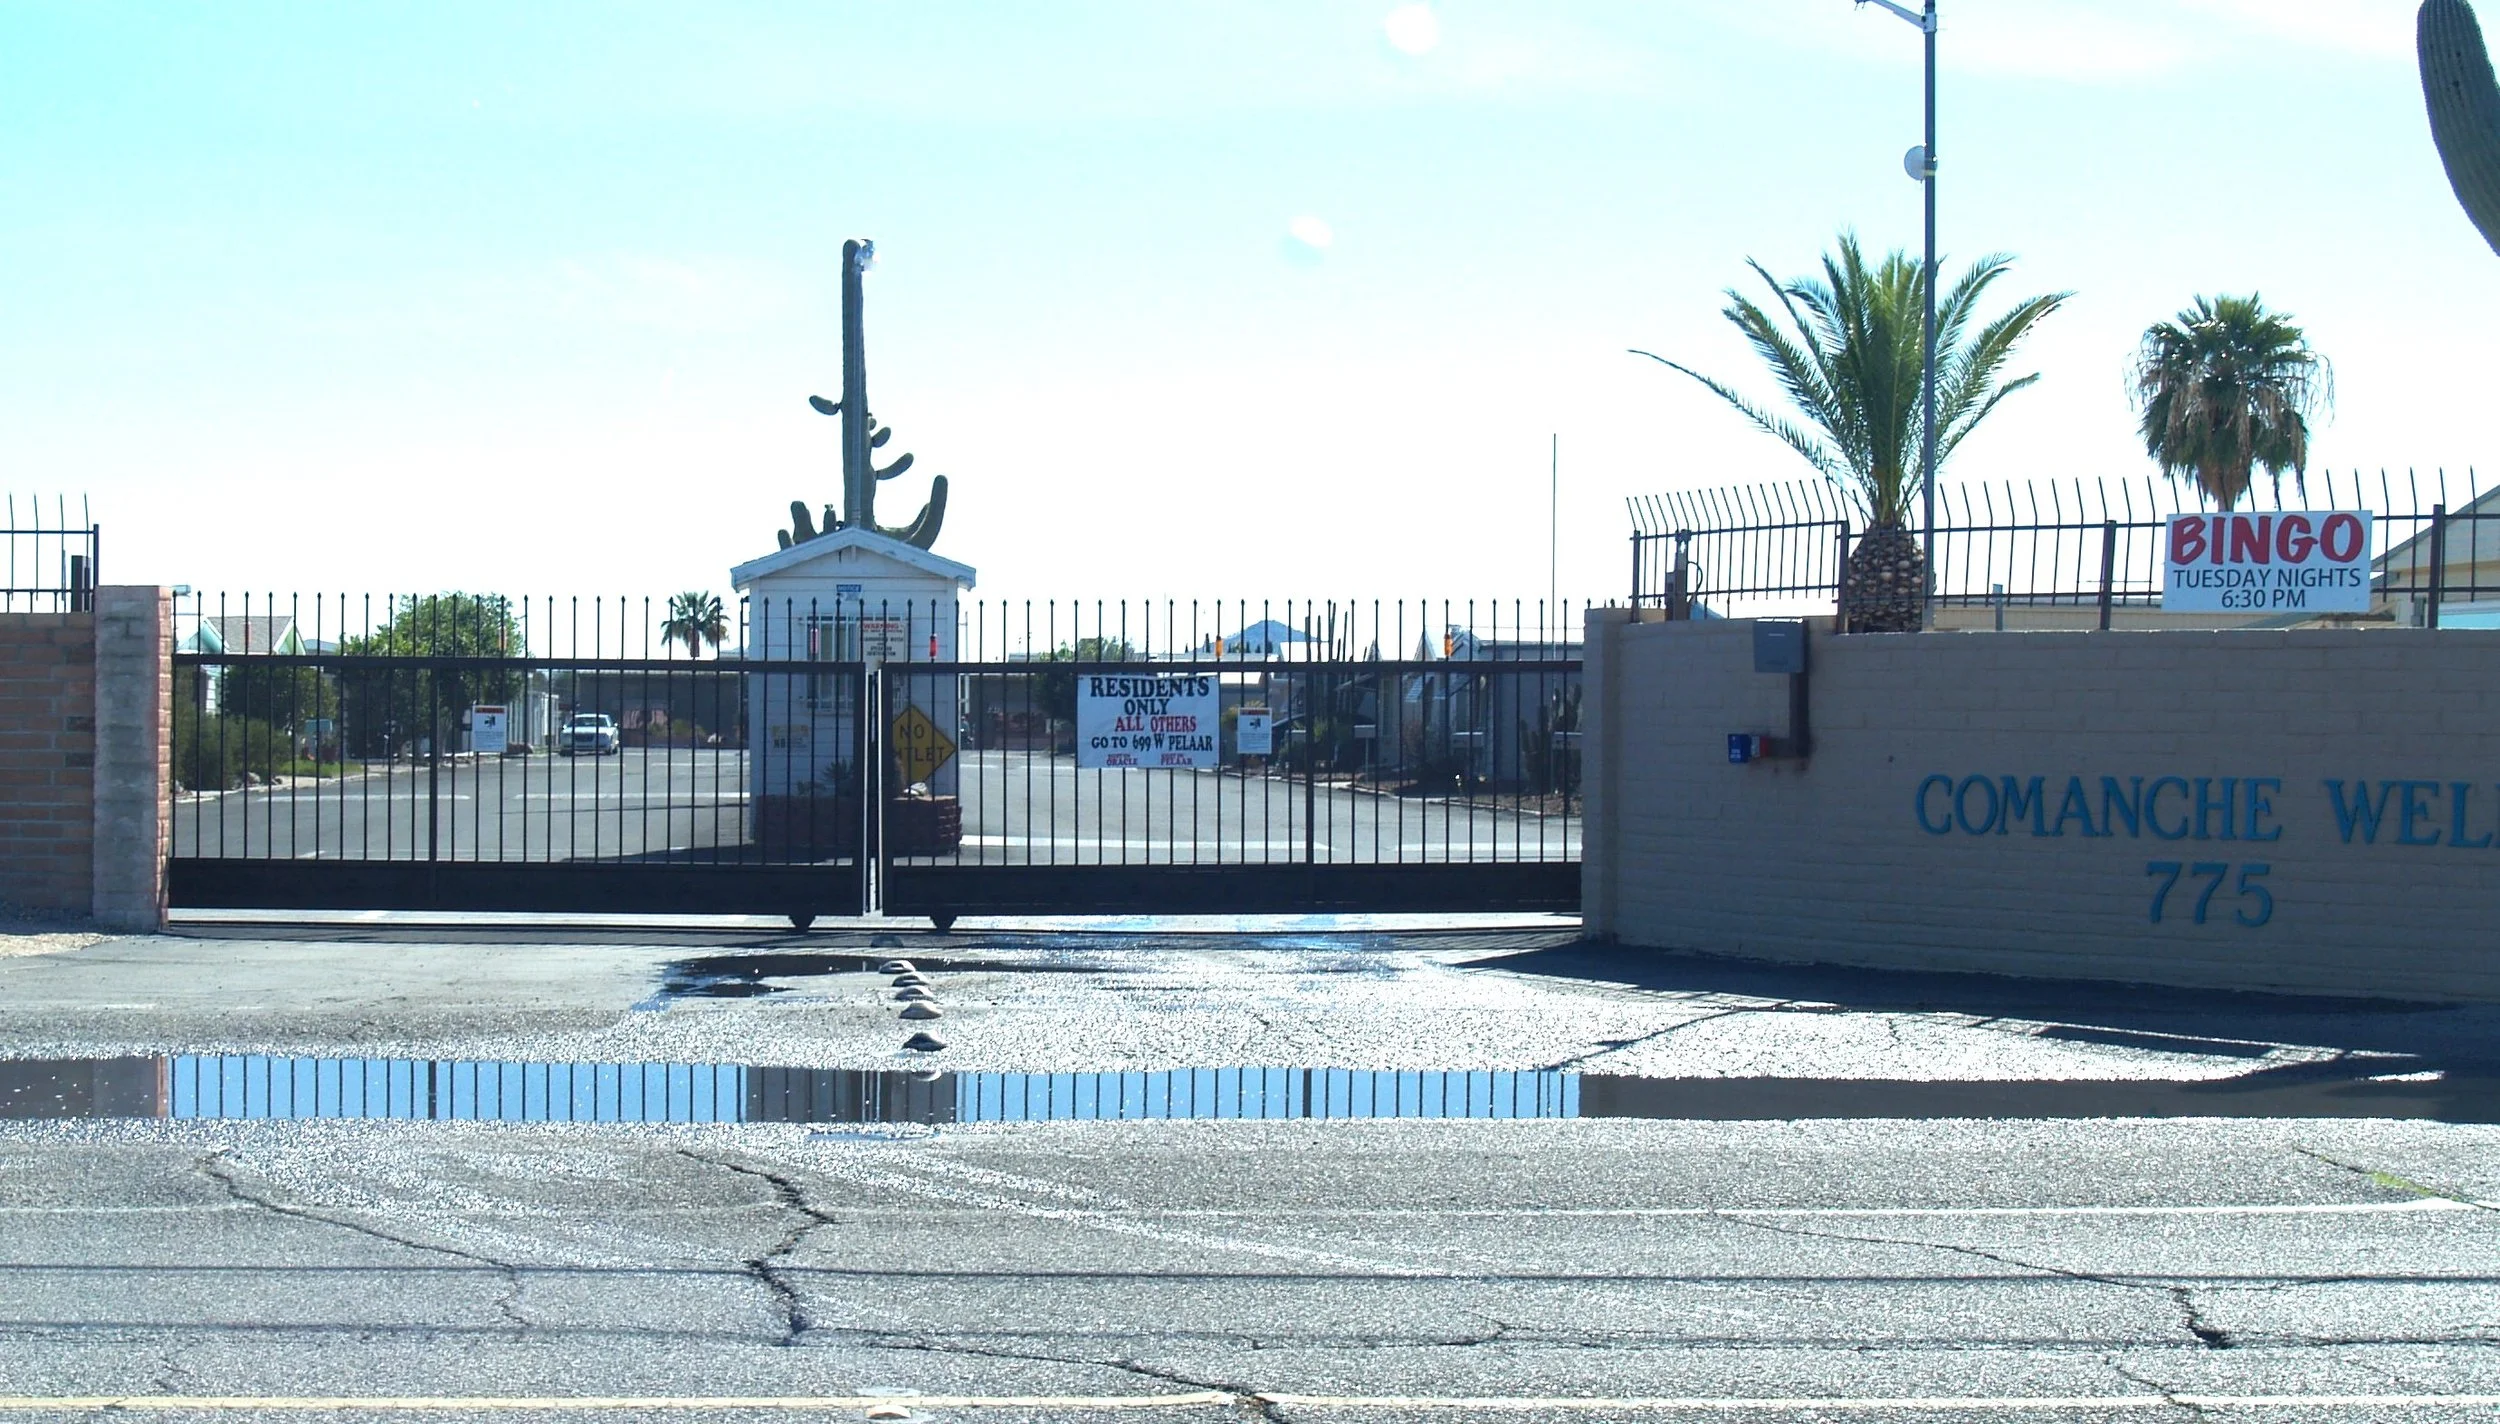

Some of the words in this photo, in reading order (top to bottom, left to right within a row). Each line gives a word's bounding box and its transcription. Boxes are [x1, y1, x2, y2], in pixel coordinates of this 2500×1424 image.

[2171, 513, 2364, 565] BINGO
[2173, 569, 2271, 588] TUESDAY
[2278, 568, 2360, 588] NIGHTS
[2222, 589, 2266, 608] 6:30
[2273, 589, 2305, 607] PM
[1090, 677, 1209, 697] RESIDENTS
[1124, 699, 1170, 715] ONLY
[900, 724, 925, 739] NO
[1115, 716, 1144, 732] ALL
[1150, 716, 1196, 732] OTHERS
[1091, 736, 1108, 749] GO
[1111, 736, 1127, 749] TO
[1132, 734, 1151, 751] 699
[1153, 734, 1164, 749] W
[1169, 735, 1212, 752] PELAAR
[1915, 774, 2282, 841] COMANCHE
[2322, 778, 2500, 848] WEL
[2147, 861, 2273, 928] 775
